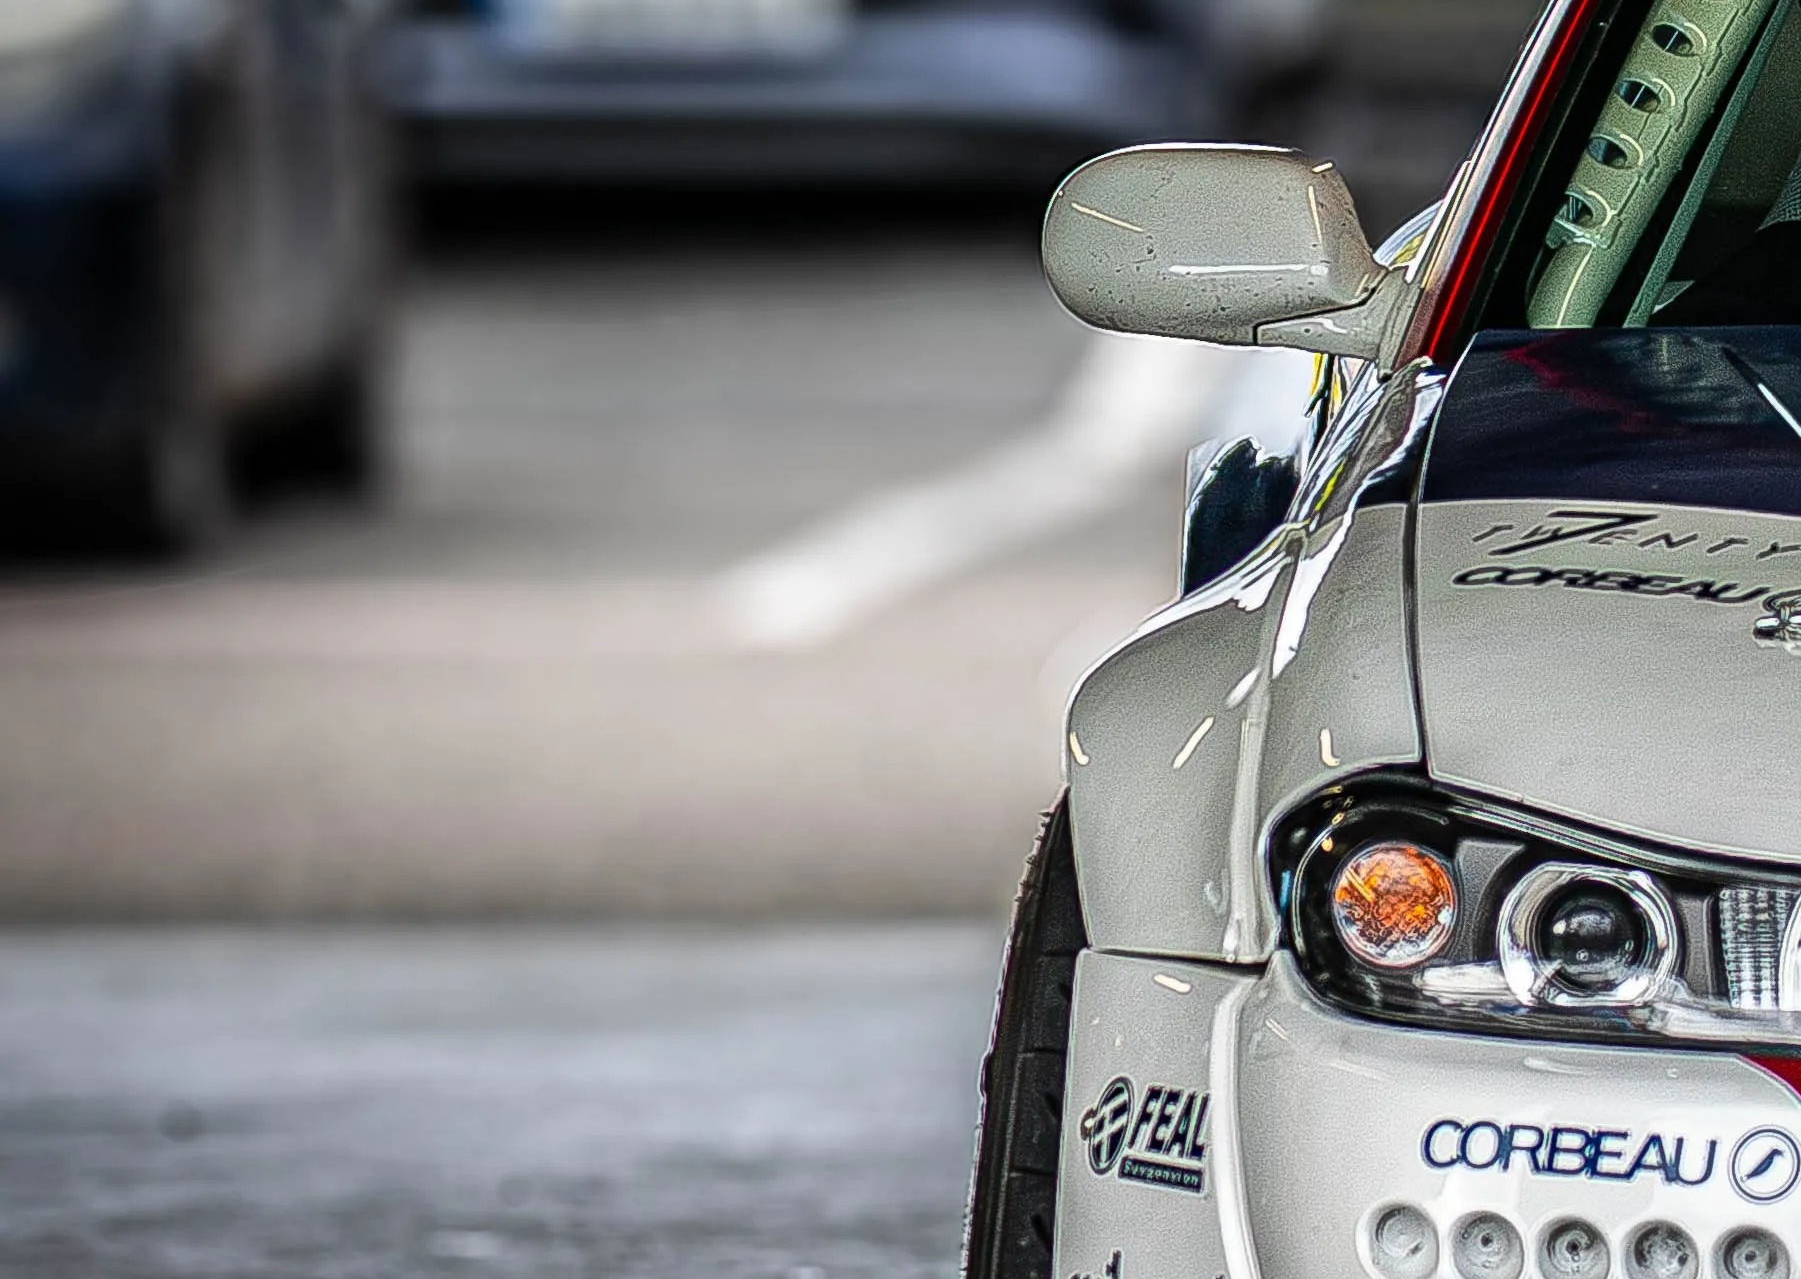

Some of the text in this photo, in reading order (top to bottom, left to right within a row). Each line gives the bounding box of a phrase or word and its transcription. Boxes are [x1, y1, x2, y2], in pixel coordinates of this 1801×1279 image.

[1452, 565, 1771, 604] CORBEAU
[1127, 1083, 1211, 1159] FEAL
[1420, 1118, 1718, 1186] CORBEAU
